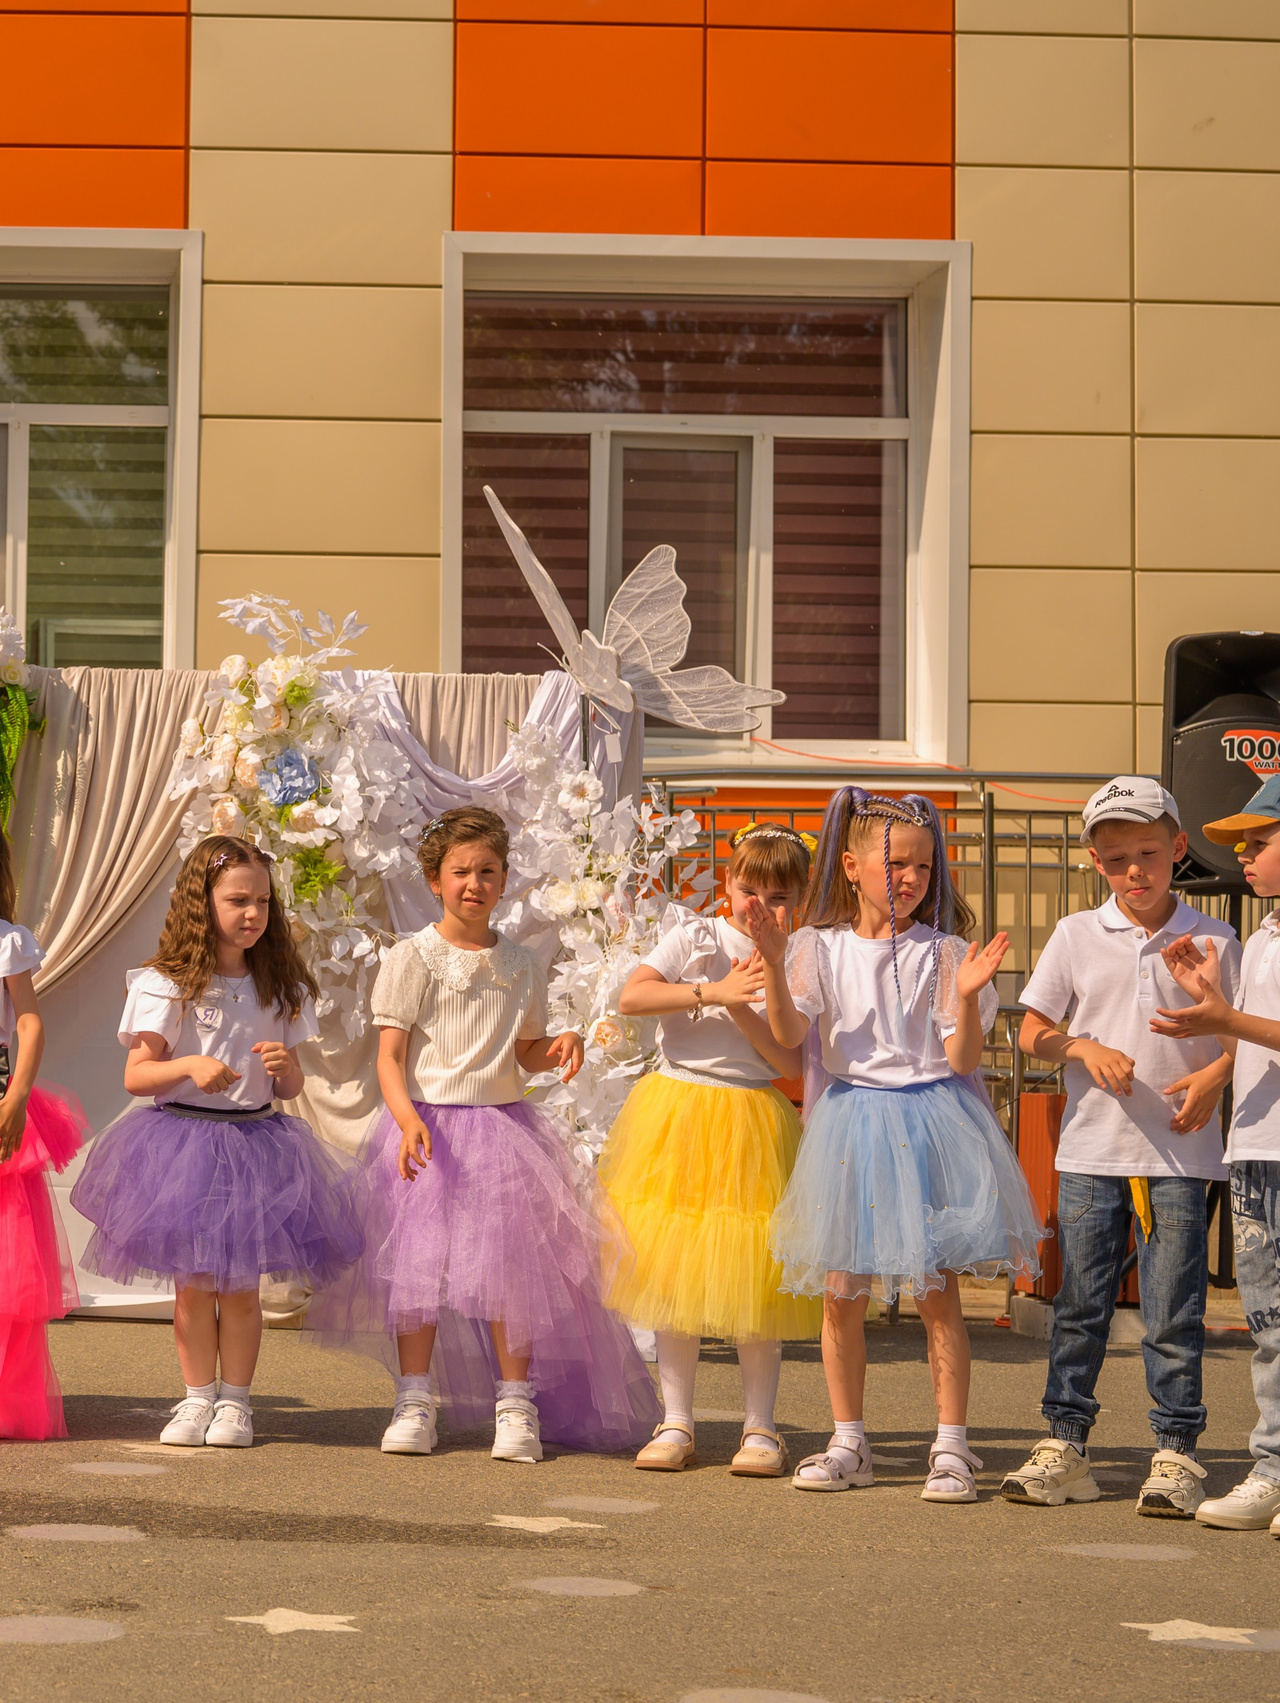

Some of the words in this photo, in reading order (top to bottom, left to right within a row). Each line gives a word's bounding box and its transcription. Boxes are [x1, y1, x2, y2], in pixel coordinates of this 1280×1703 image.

[1222, 737, 1280, 760] 100
[1094, 788, 1135, 808] Reebok
[202, 1007, 216, 1021] Я
